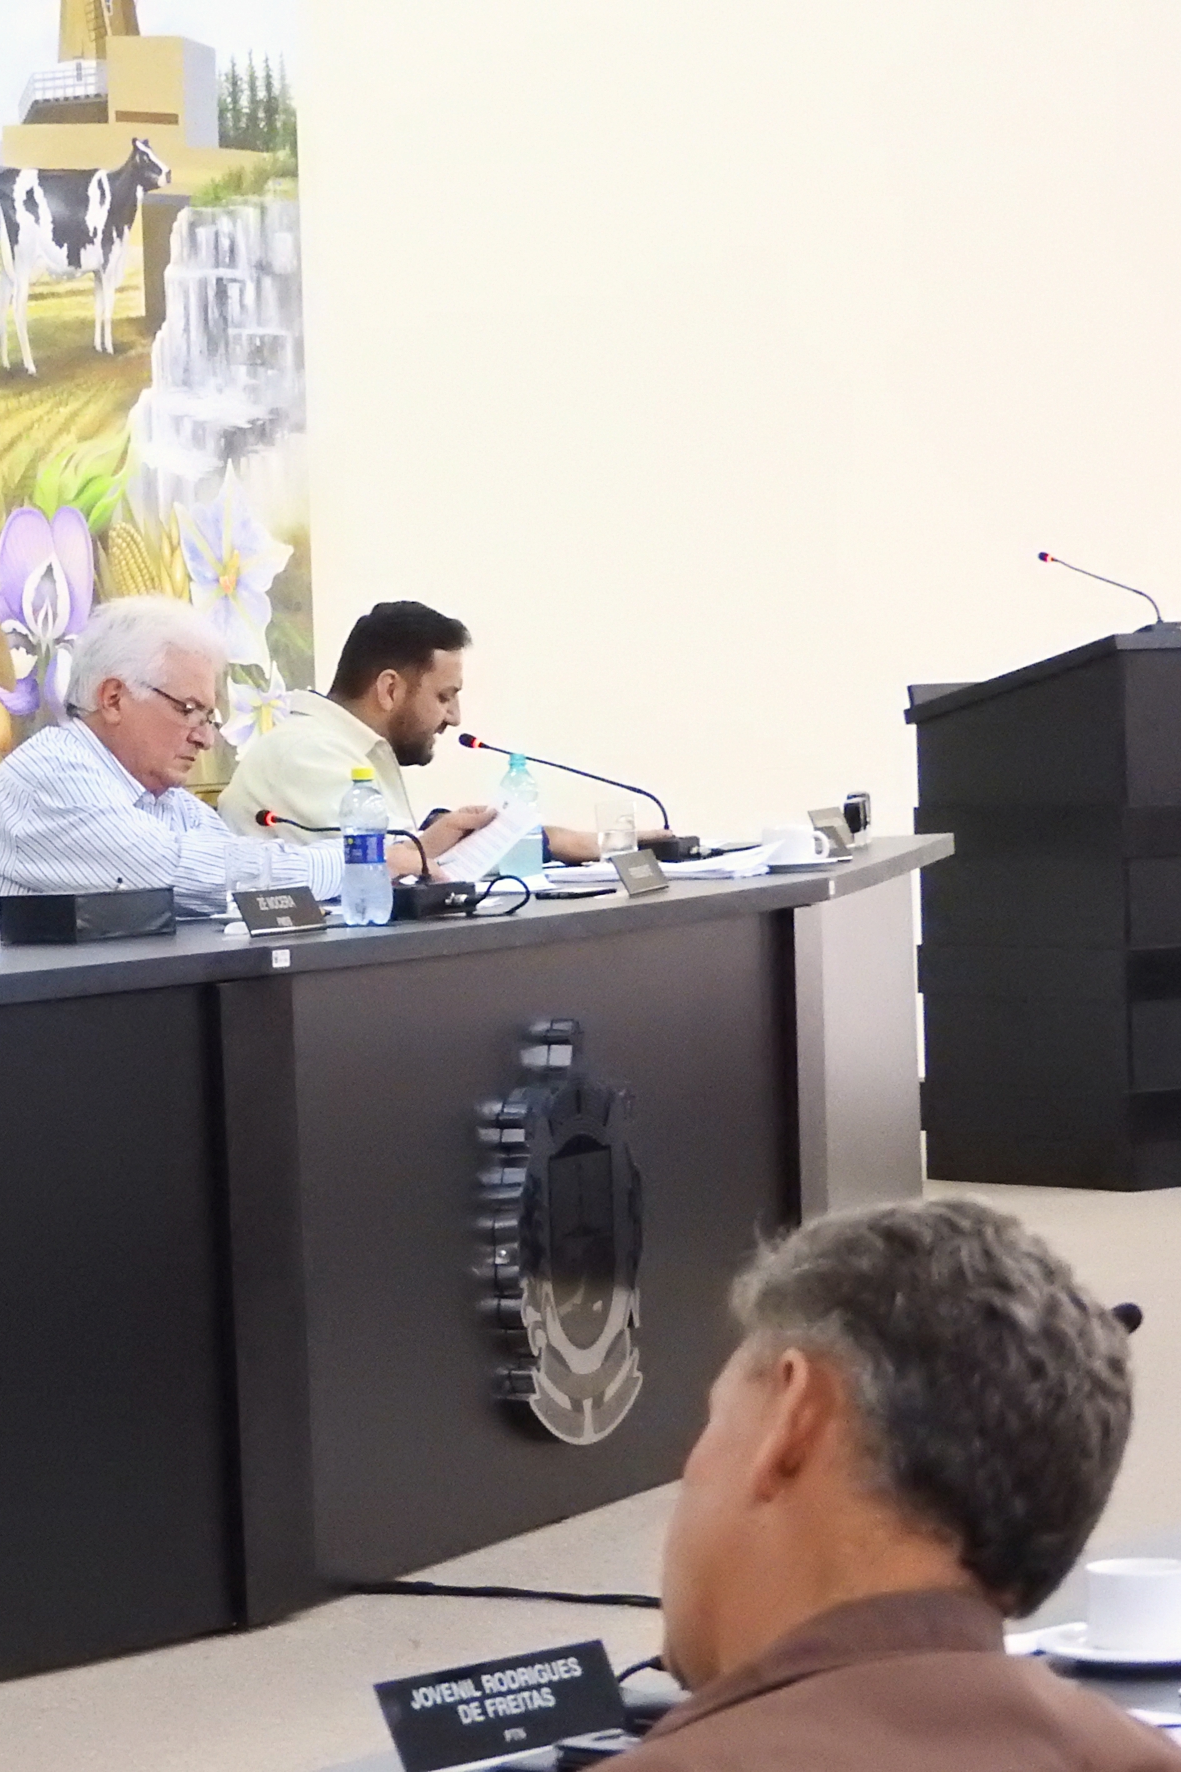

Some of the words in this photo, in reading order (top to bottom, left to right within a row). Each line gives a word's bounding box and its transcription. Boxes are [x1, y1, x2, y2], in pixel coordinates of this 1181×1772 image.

[410, 1678, 482, 1710] JOVENIL
[480, 1657, 583, 1694] RODRIGUES
[457, 1702, 485, 1725] DE
[484, 1687, 557, 1719] FREITAS
